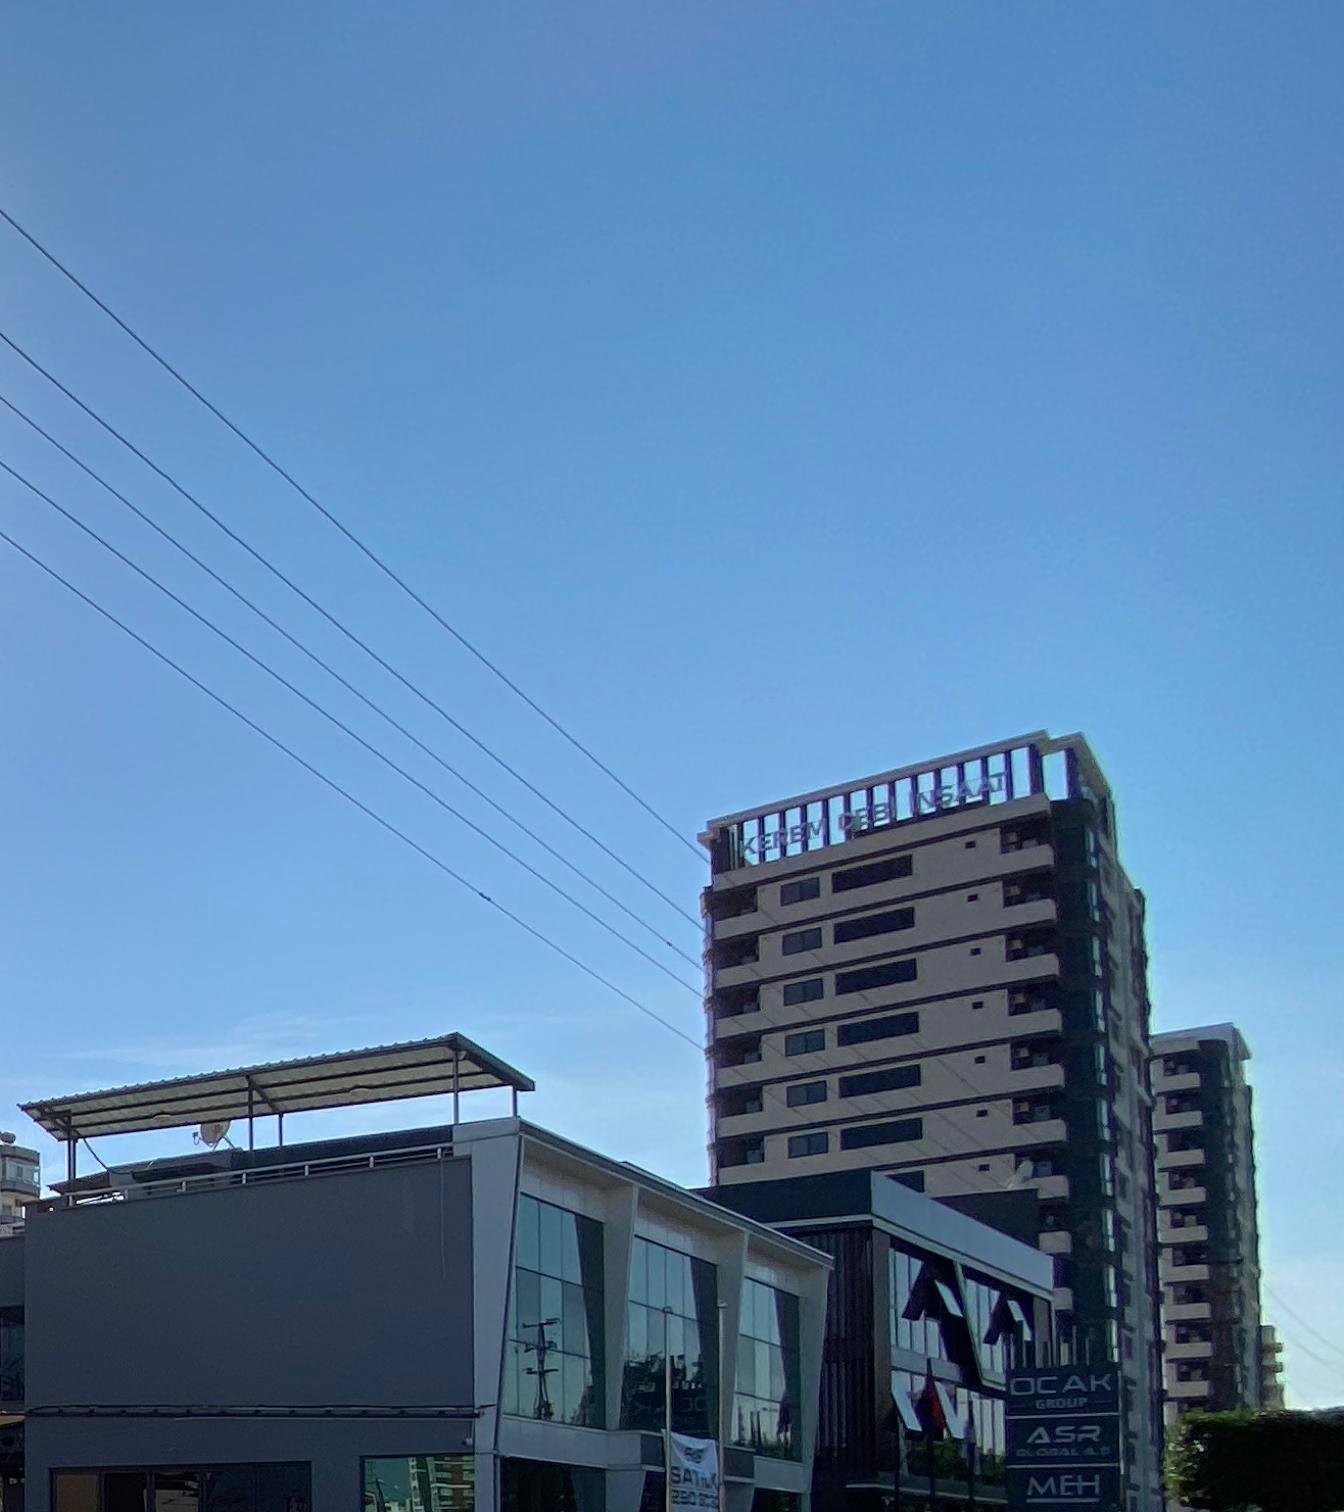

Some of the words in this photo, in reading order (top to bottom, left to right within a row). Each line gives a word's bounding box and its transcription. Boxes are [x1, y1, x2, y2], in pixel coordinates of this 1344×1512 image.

[1011, 1374, 1112, 1395] OCAK
[1036, 1398, 1088, 1410] GROUP
[1026, 1425, 1101, 1444] ASR
[1026, 1474, 1101, 1496] MEH
